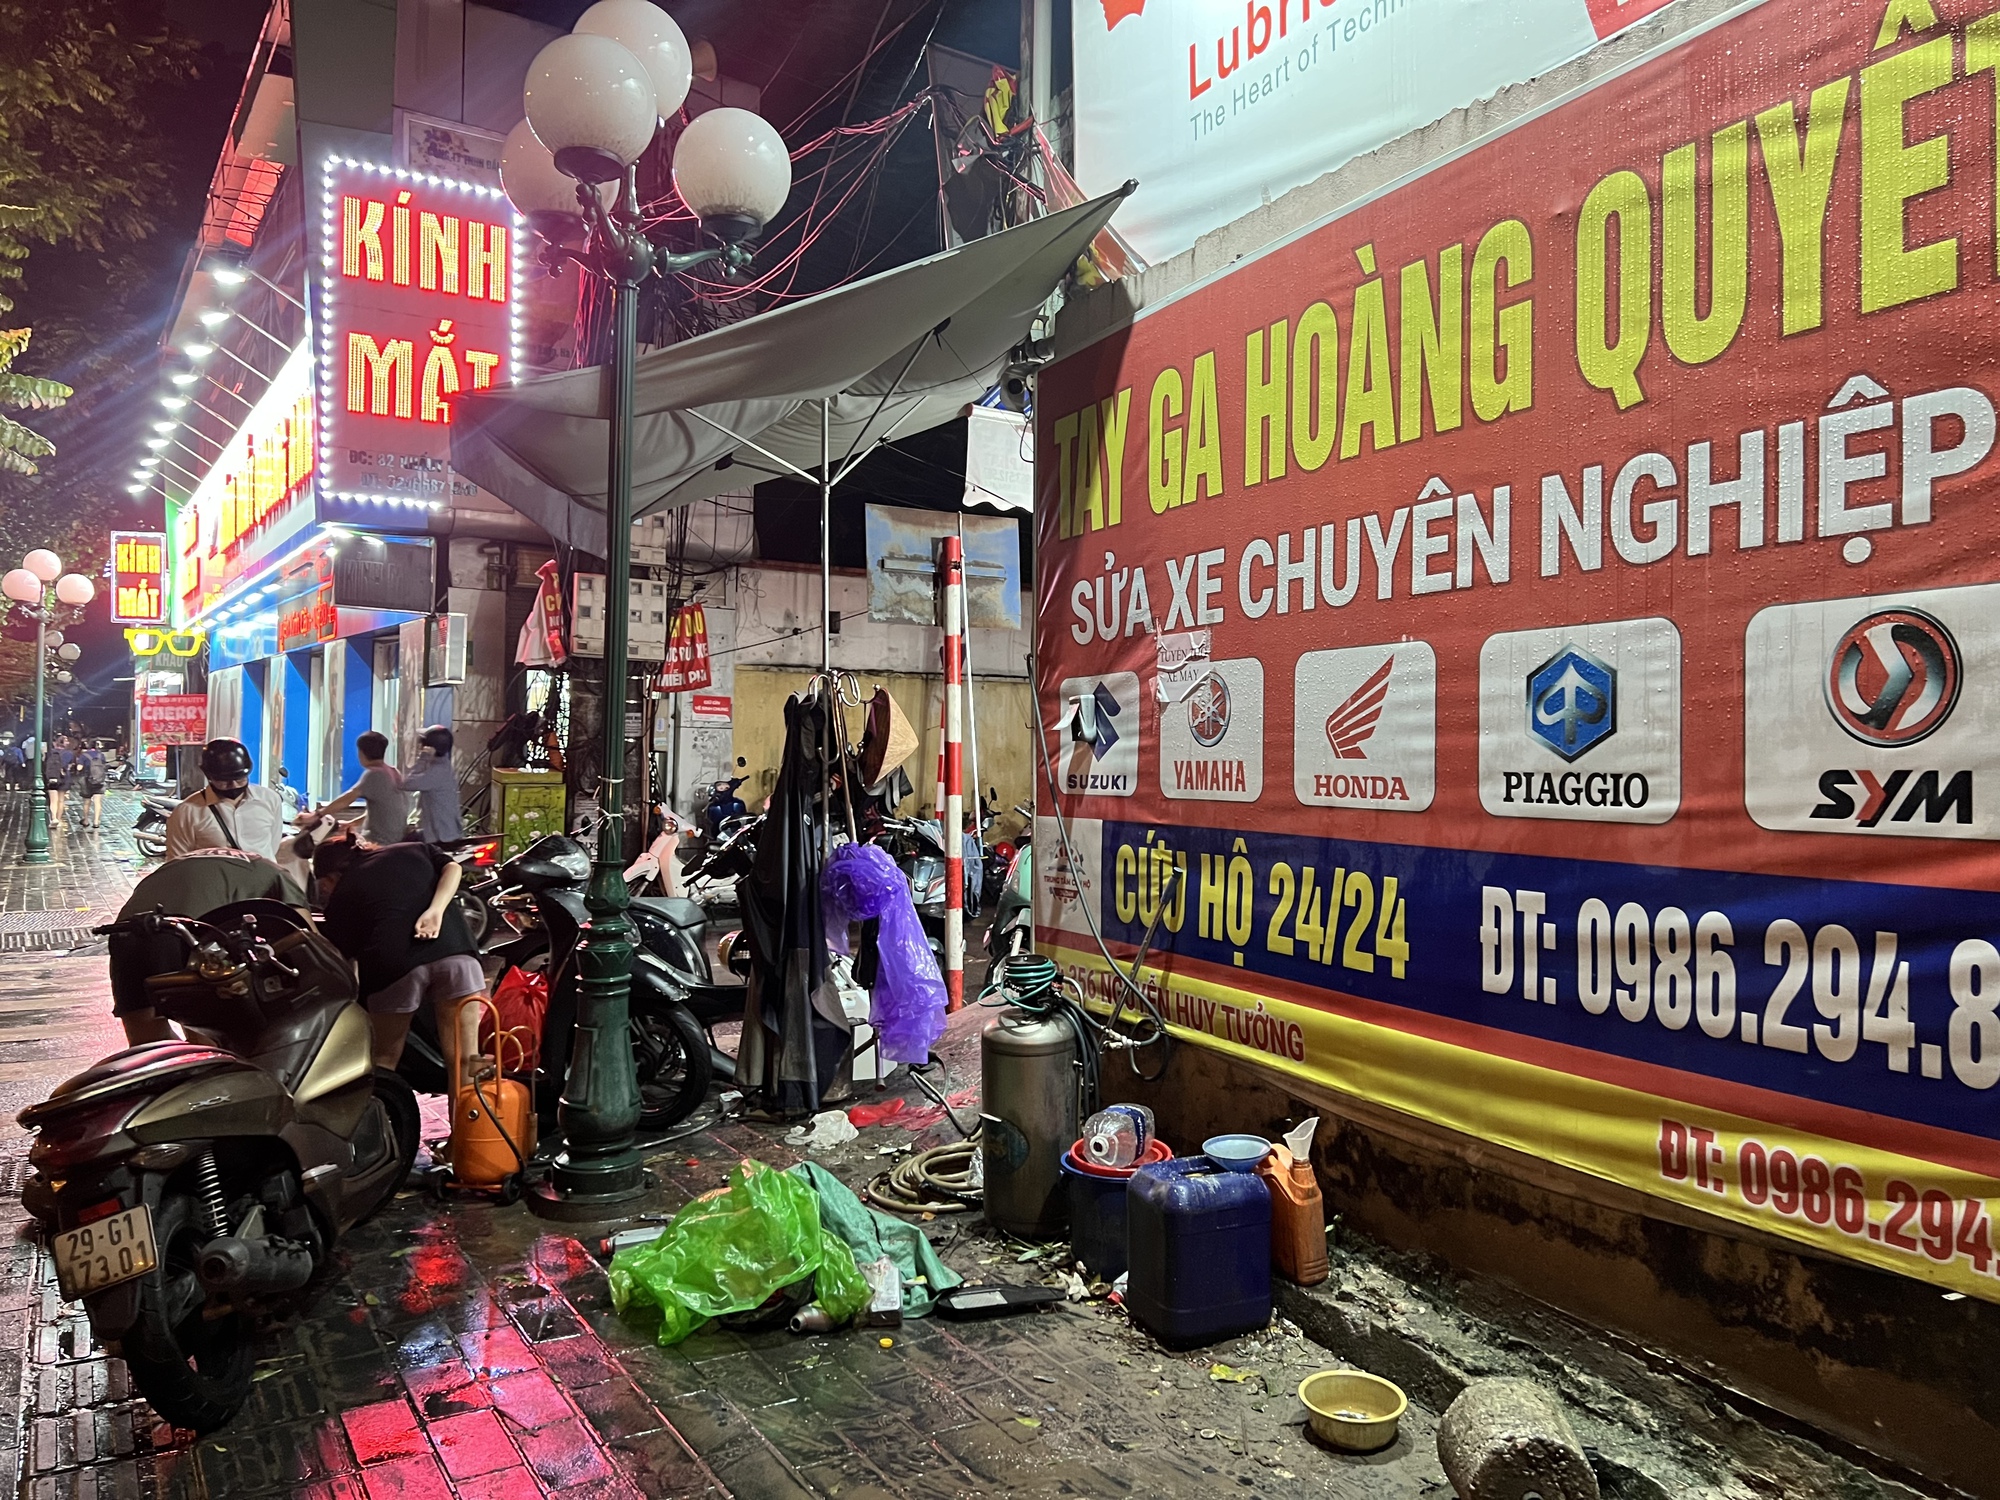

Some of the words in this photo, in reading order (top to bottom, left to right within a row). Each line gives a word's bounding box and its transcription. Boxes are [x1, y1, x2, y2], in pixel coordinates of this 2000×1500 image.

[1190, 104, 1225, 141] The
[1233, 55, 1290, 116] Heart
[1298, 32, 1318, 72] of
[342, 190, 506, 303] KÍNH
[347, 319, 499, 424] MẮT
[1054, 388, 1132, 541] TAY
[1148, 350, 1223, 515] GA
[1245, 219, 1532, 487] HOÀNG
[1071, 551, 1153, 646] SỬA
[1165, 547, 1225, 631] XE
[1238, 477, 1511, 619] CHUYÊN
[1541, 375, 1997, 577] NGHIỆP
[117, 538, 160, 574] KÍNH
[118, 578, 160, 618] MẮT
[1179, 666, 1199, 682] MÁY
[142, 705, 207, 721] CHERRY
[1067, 773, 1127, 791] SUZUKI
[1173, 760, 1247, 793] YAMAHA
[1313, 774, 1410, 801] HONDA
[1503, 771, 1650, 809] PIAGGIO
[1809, 769, 1974, 828] SYM
[1115, 829, 1187, 933] CỨU
[1198, 837, 1253, 967] HỘ
[1266, 861, 1410, 980] 24/24
[1068, 964, 1096, 999] 356
[1100, 972, 1171, 1022] NGUYỄN
[1175, 992, 1217, 1035] HUY
[1221, 1001, 1305, 1062] TƯỞNG
[1480, 885, 1557, 1005] ĐT:
[1577, 897, 2000, 1090] 0986.294.8
[1659, 1118, 1724, 1194] ĐT:
[1740, 1141, 2000, 1276] 0986.294
[66, 1212, 135, 1263] 29-G1
